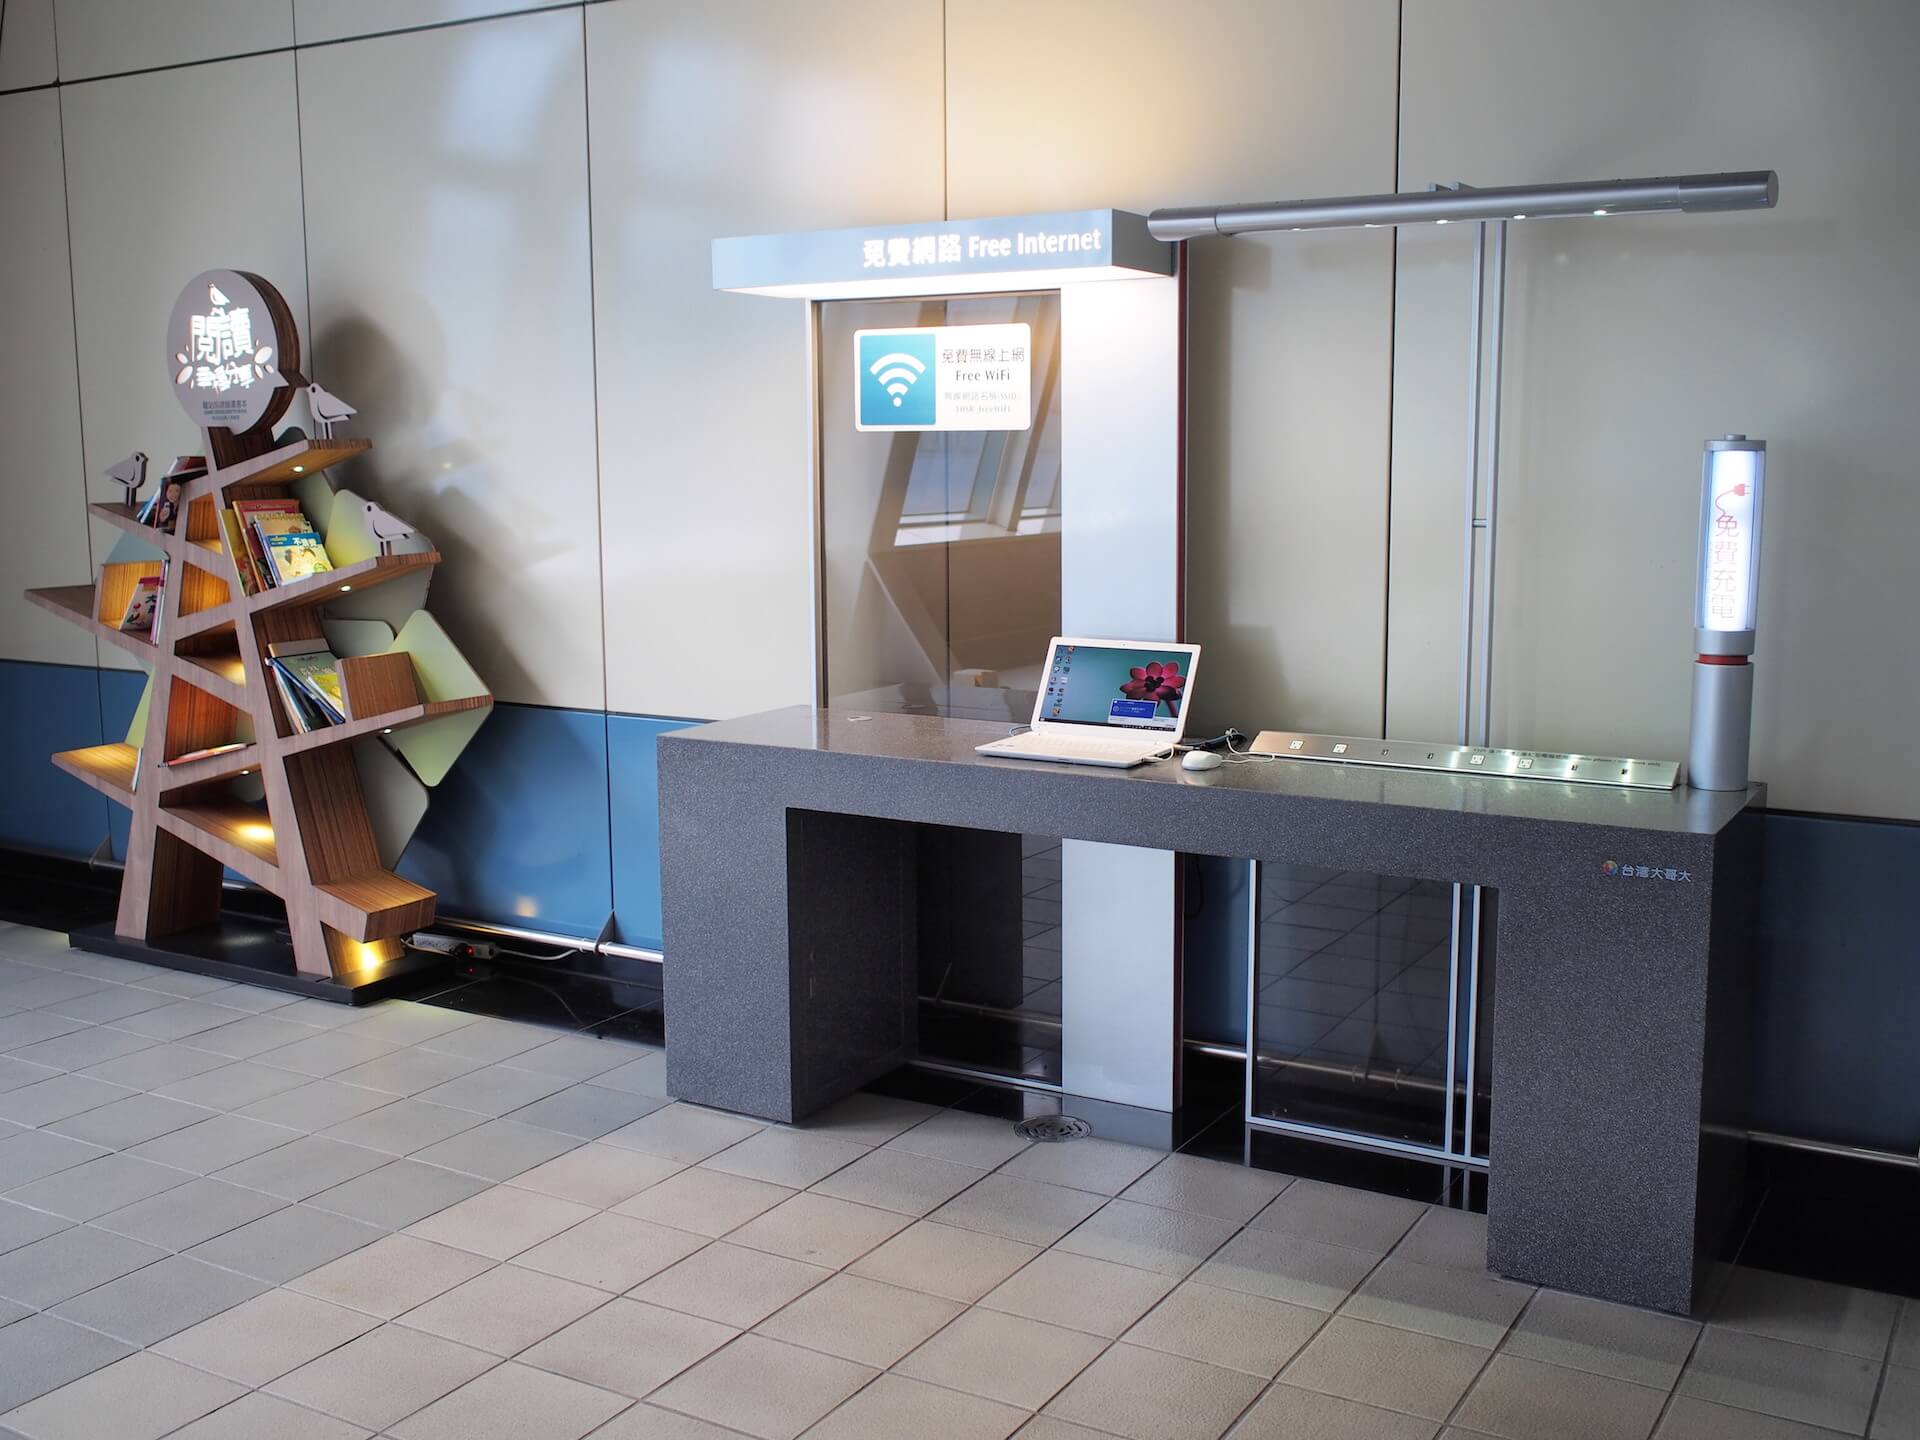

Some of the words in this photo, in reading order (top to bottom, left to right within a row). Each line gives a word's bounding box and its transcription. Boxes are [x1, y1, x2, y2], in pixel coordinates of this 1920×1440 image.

[863, 234, 961, 267] 免費網路
[969, 236, 1011, 258] Free
[1018, 229, 1101, 255] Internet
[192, 308, 254, 365] 閱讀
[942, 347, 1025, 364] 免費無線上網
[955, 369, 981, 382] Free
[985, 368, 1010, 381] WiFi
[1711, 515, 1740, 619] 免費充電
[1621, 864, 1692, 882] 台灣大哥大
